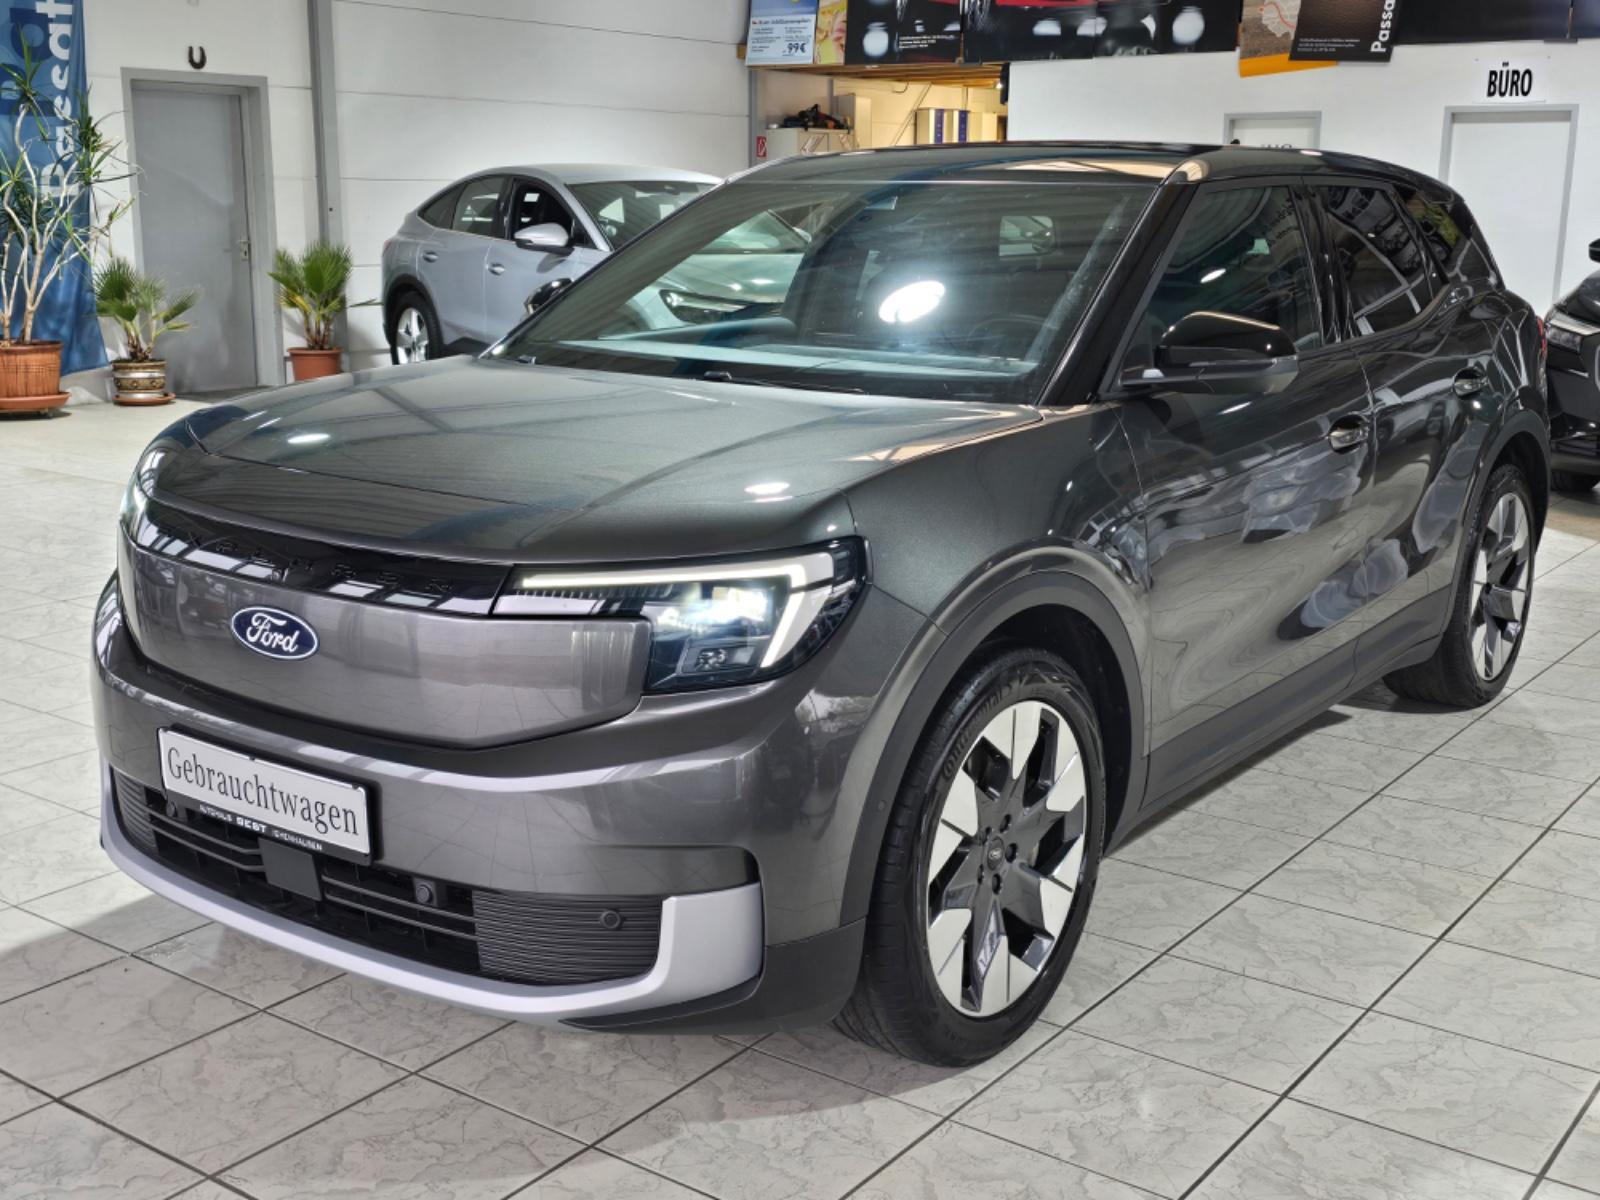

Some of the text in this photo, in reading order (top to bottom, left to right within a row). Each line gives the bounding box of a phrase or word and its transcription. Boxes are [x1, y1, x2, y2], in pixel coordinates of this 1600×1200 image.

[1370, 0, 1396, 52] Passa
[787, 42, 807, 54] 99€
[1486, 61, 1534, 98] BÜRO
[245, 612, 300, 653] Ford
[167, 746, 360, 837] Gebrauchtwagen
